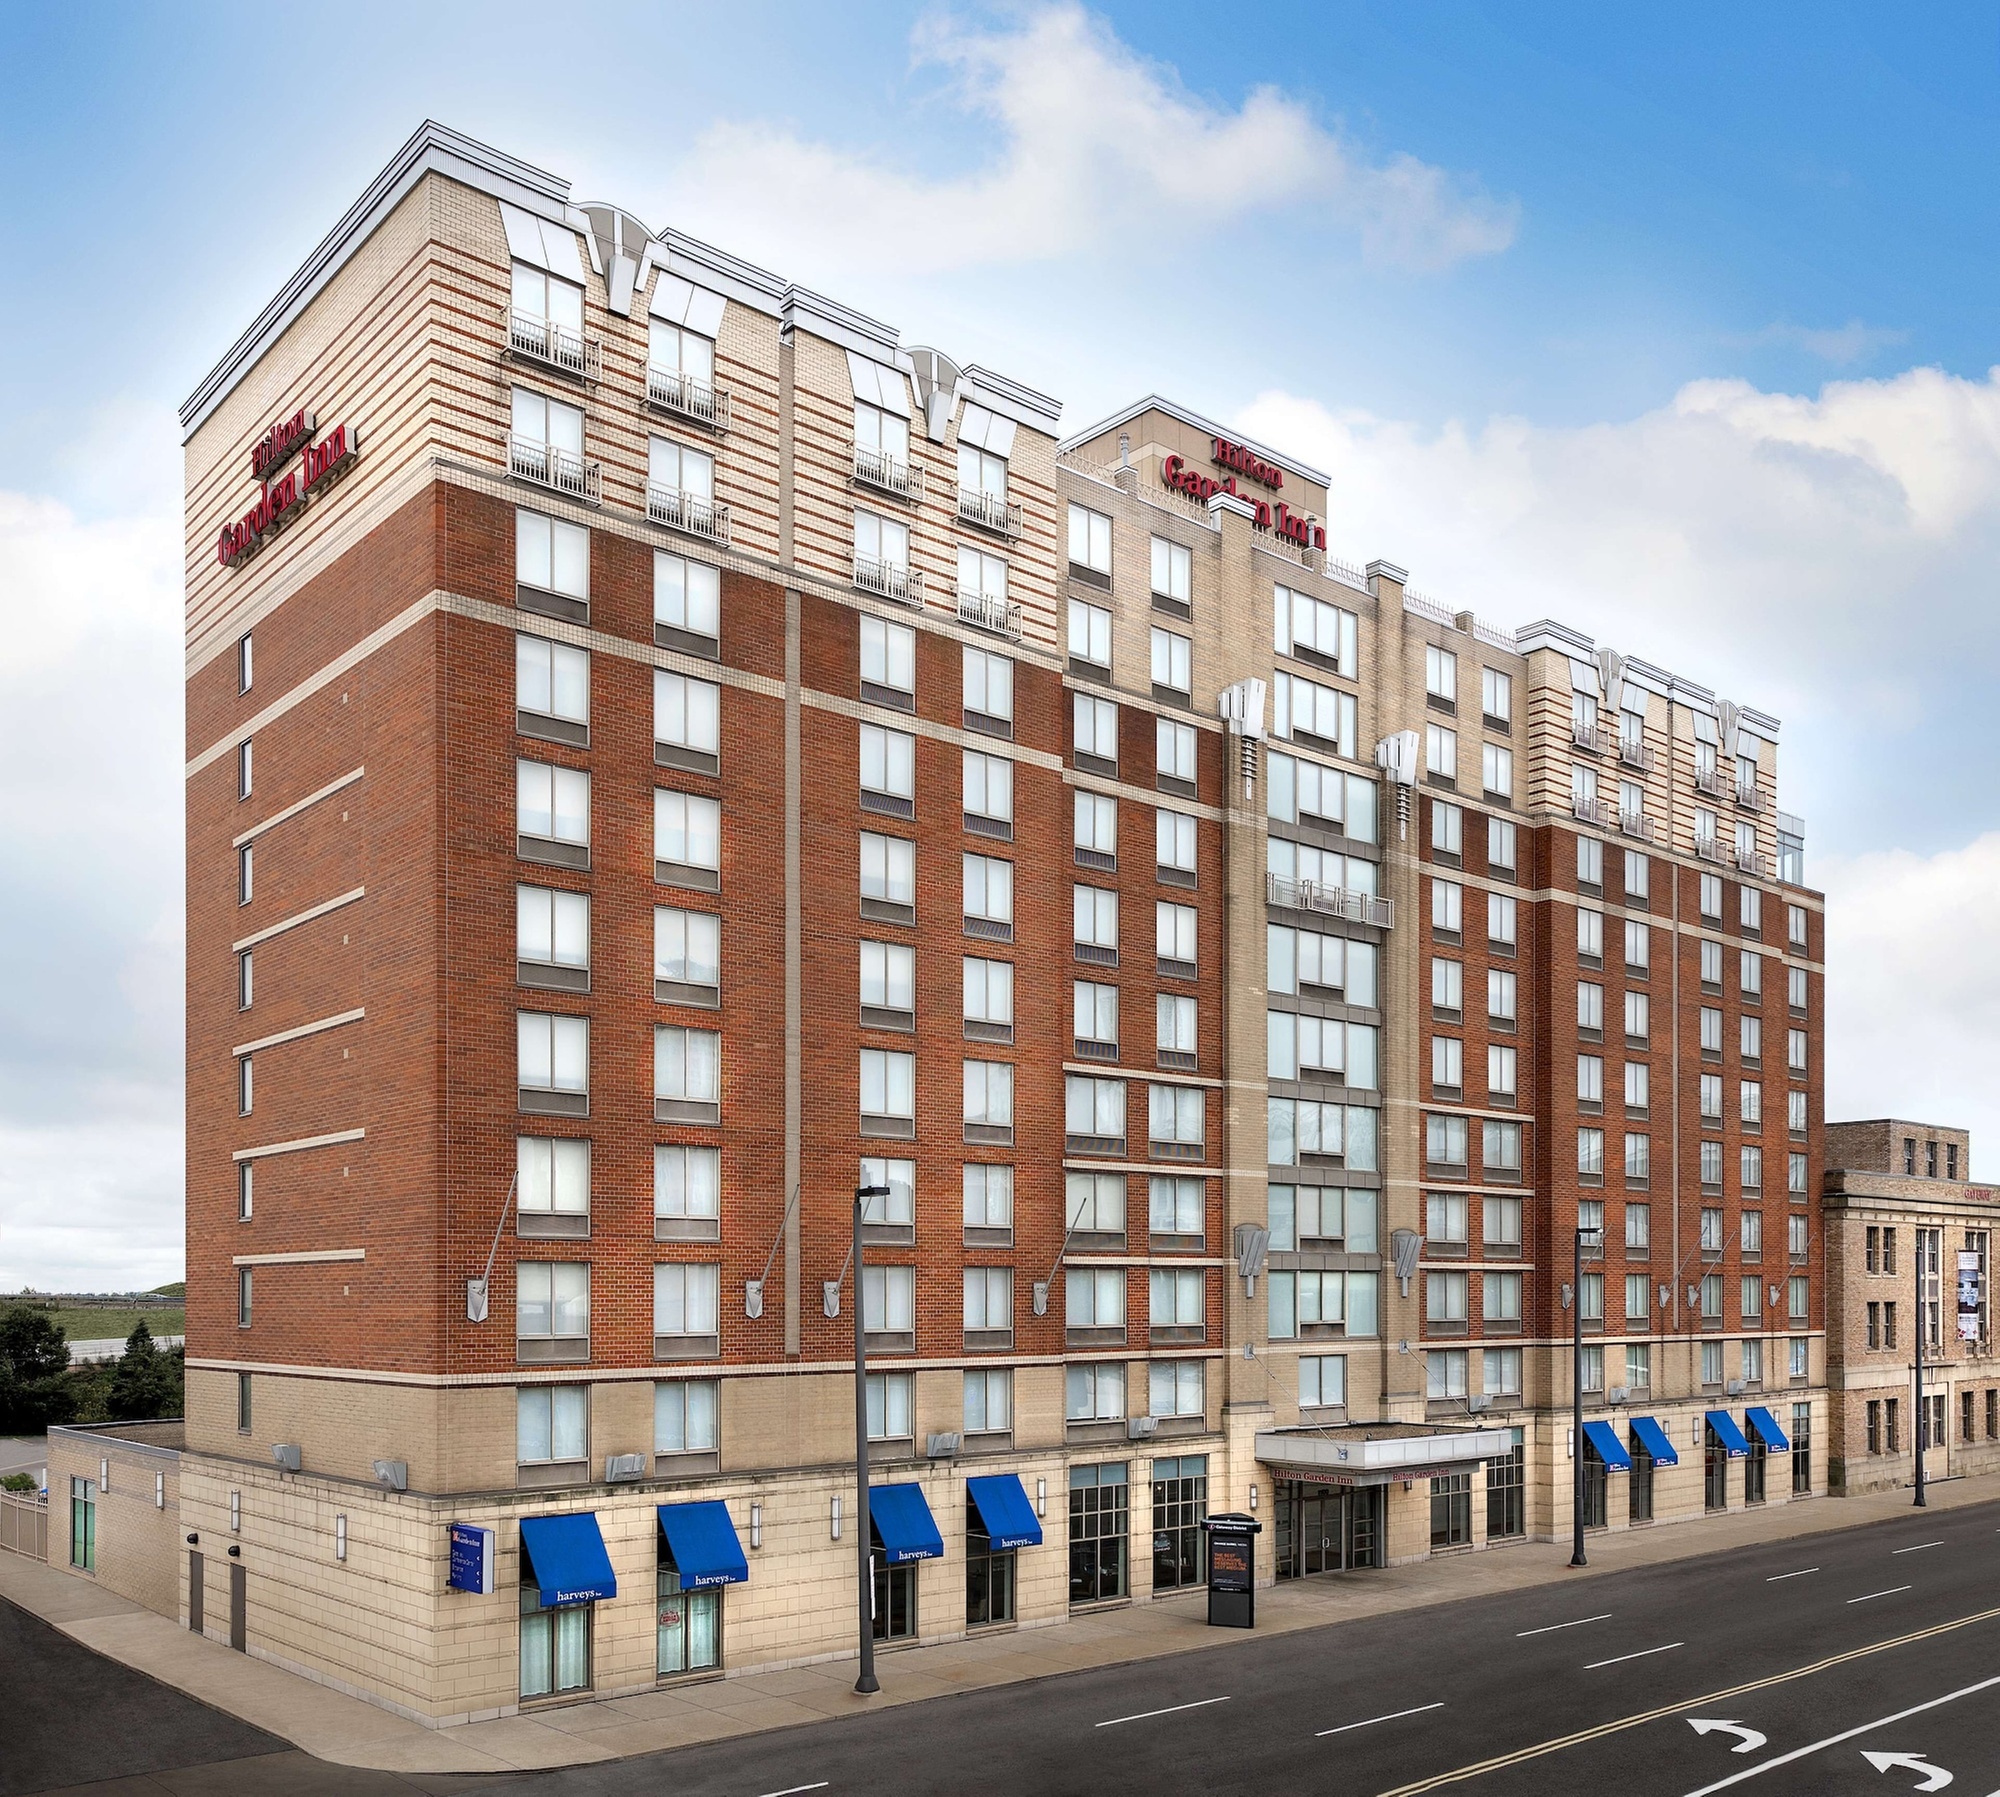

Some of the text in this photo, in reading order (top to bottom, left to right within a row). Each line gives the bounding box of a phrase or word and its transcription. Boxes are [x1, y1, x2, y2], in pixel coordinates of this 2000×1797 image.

[252, 409, 306, 478] Hilton
[1215, 437, 1283, 488] Hilton
[218, 424, 347, 566] Garden Inn
[1274, 1469, 1353, 1485] Hilton Garden Inn
[1392, 1473, 1414, 1481] Hilton
[1414, 1470, 1438, 1479] Garden
[1001, 1538, 1028, 1547] harveys
[899, 1550, 927, 1560] harveys
[695, 1575, 729, 1586] harveys
[557, 1589, 595, 1601] harveys
